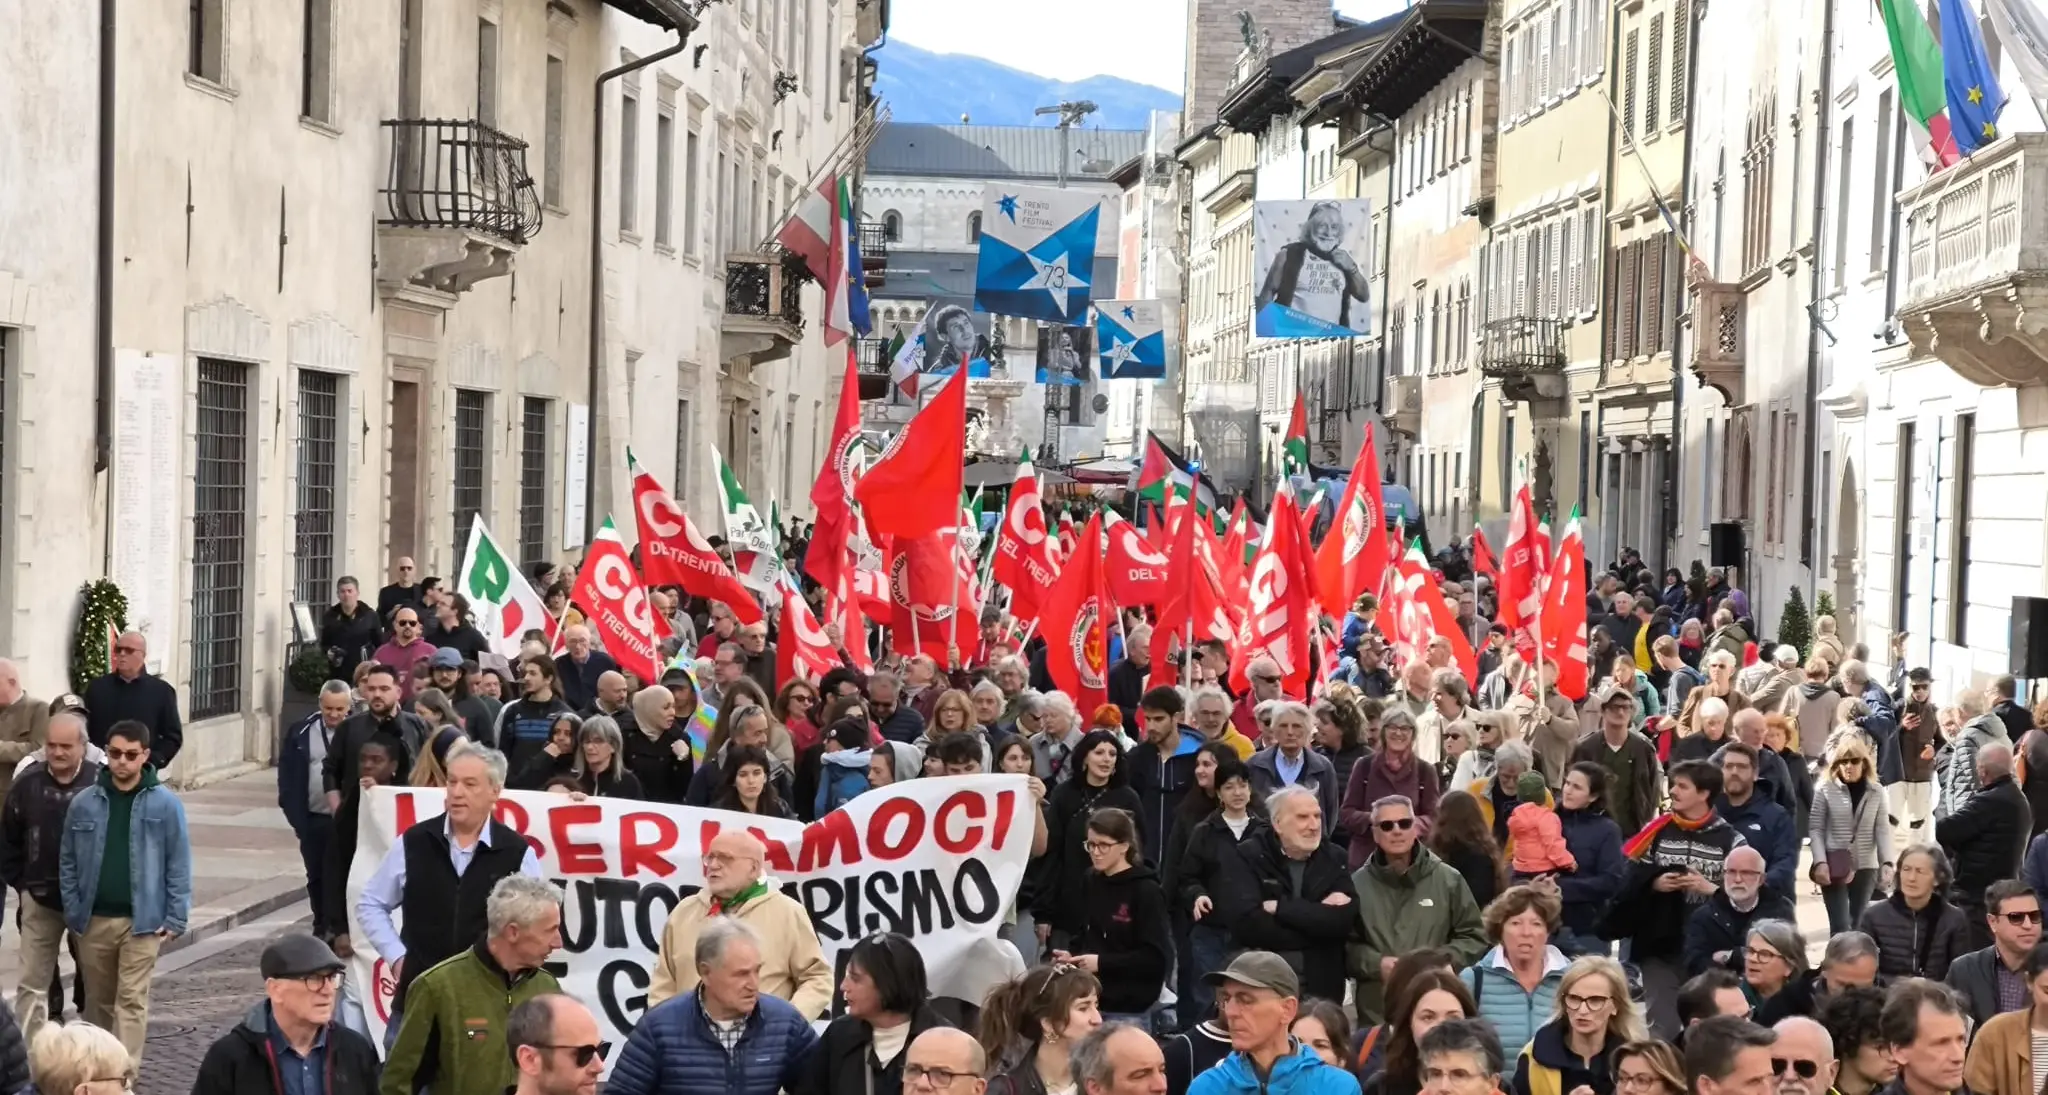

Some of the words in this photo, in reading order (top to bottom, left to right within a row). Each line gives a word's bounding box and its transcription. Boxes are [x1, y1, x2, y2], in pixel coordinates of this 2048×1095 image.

[1023, 200, 1050, 210] TRENTO
[1023, 209, 1040, 217] FILM
[1022, 216, 1054, 227] FESTIVAL
[670, 546, 733, 578] TRENTIN
[1128, 567, 1157, 582] DEL
